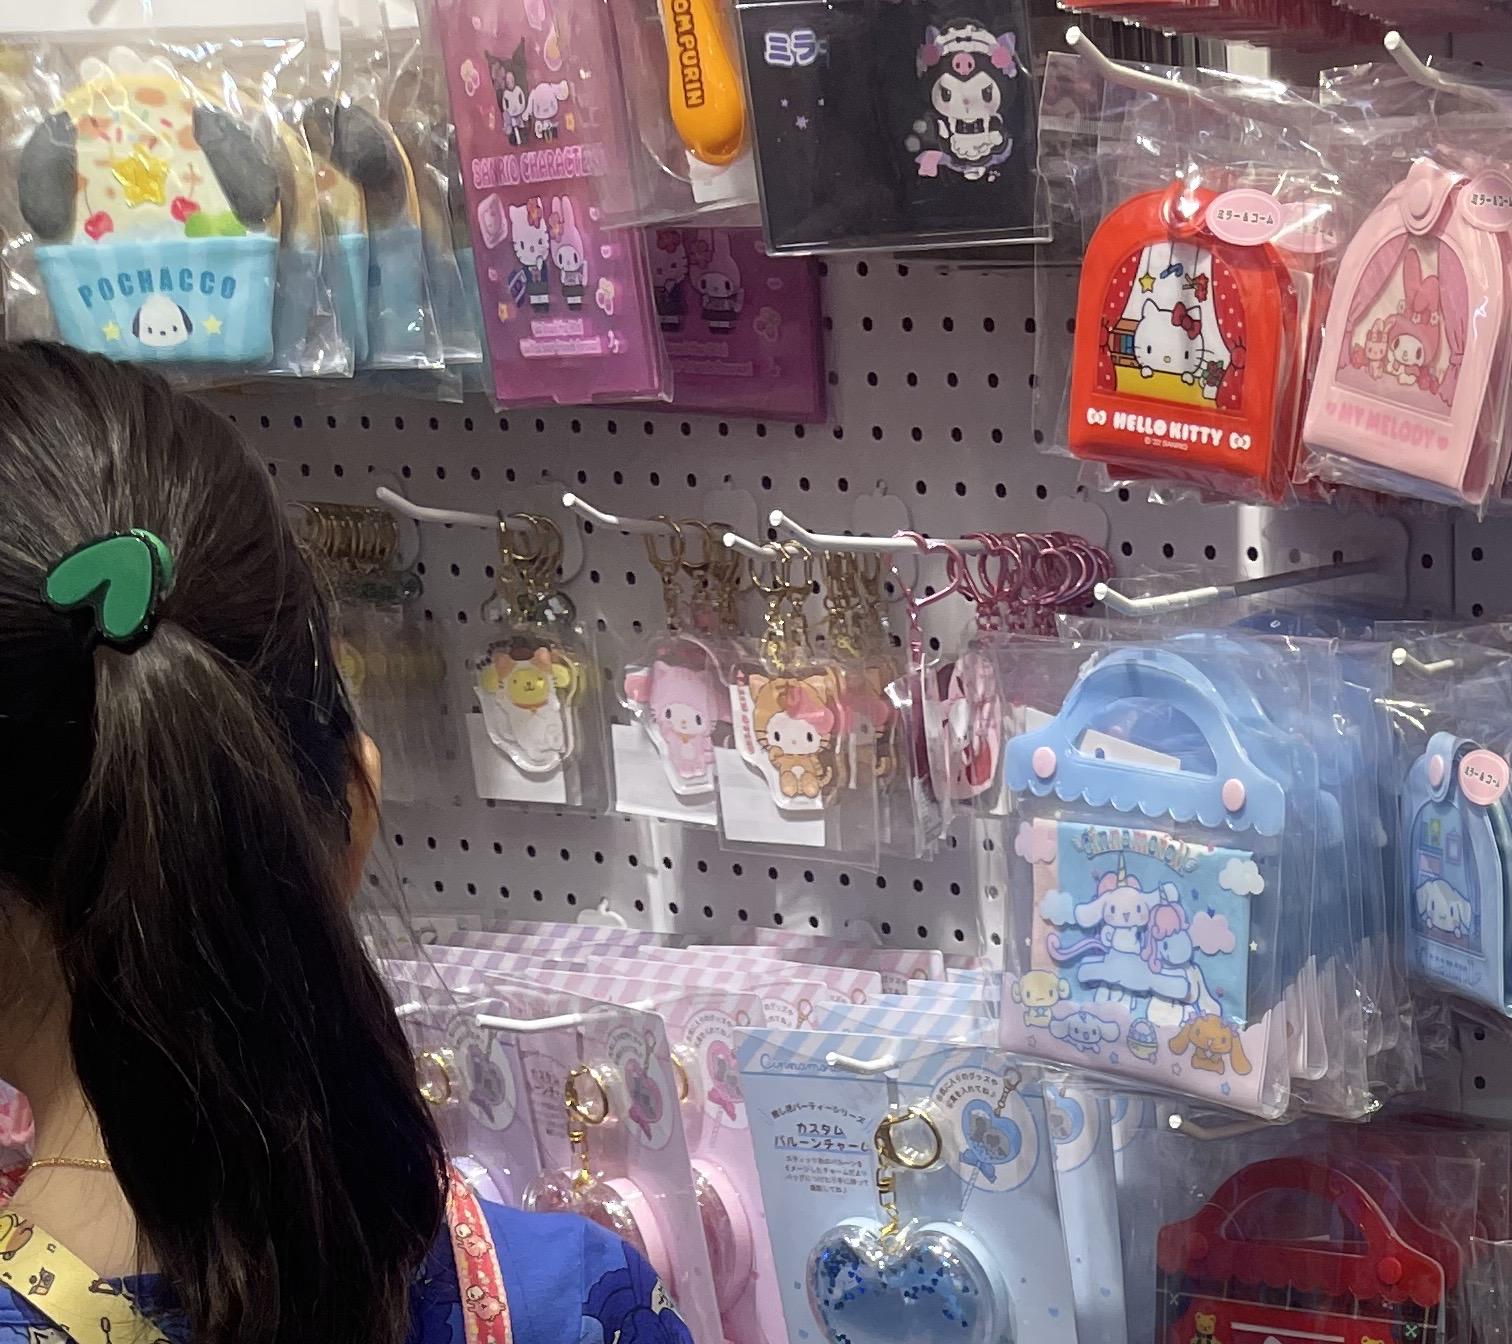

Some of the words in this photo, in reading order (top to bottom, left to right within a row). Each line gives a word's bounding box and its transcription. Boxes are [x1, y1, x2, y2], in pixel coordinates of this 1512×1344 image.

[78, 267, 237, 308] POCHACCO
[1113, 411, 1167, 435] HELLO
[1169, 420, 1223, 447] KITTY
[796, 1122, 846, 1136] カスタム
